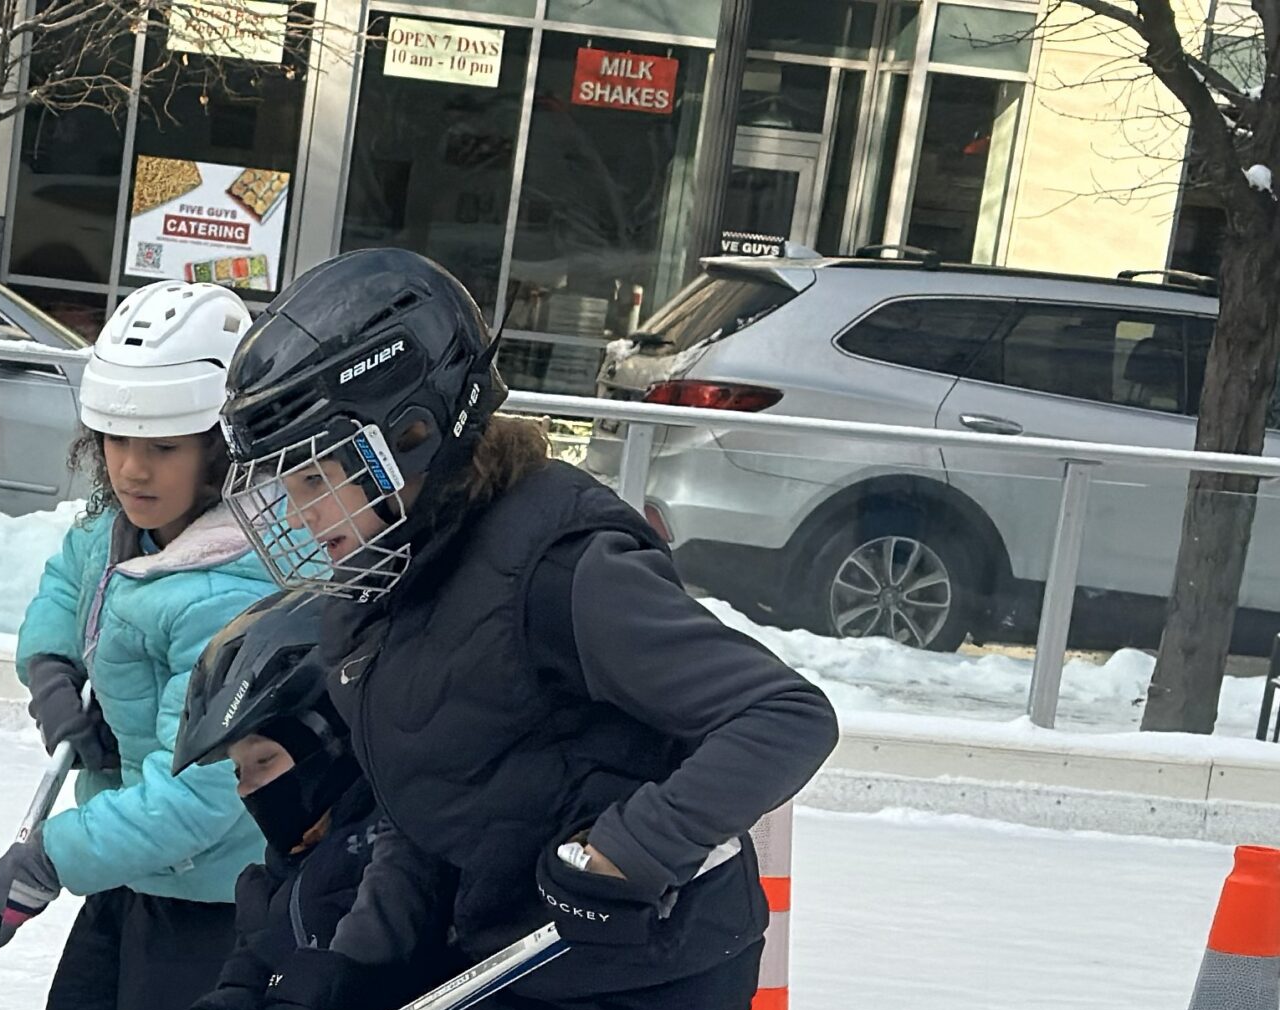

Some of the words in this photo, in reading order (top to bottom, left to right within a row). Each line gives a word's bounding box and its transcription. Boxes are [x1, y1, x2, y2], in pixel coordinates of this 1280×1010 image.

[391, 28, 437, 48] OPEN
[442, 34, 452, 50] 7
[457, 36, 500, 57] DAYS
[391, 47, 407, 63] 10
[410, 54, 433, 67] am
[449, 55, 466, 71] 10
[469, 61, 494, 76] pm
[601, 56, 654, 81] MILK
[579, 81, 670, 109] SHAKES
[179, 203, 204, 215] FIVE
[207, 206, 238, 219] GUYS
[166, 219, 246, 240] CATERING
[721, 240, 739, 253] VE
[742, 242, 780, 256] GUYS
[339, 340, 405, 385] BAUER
